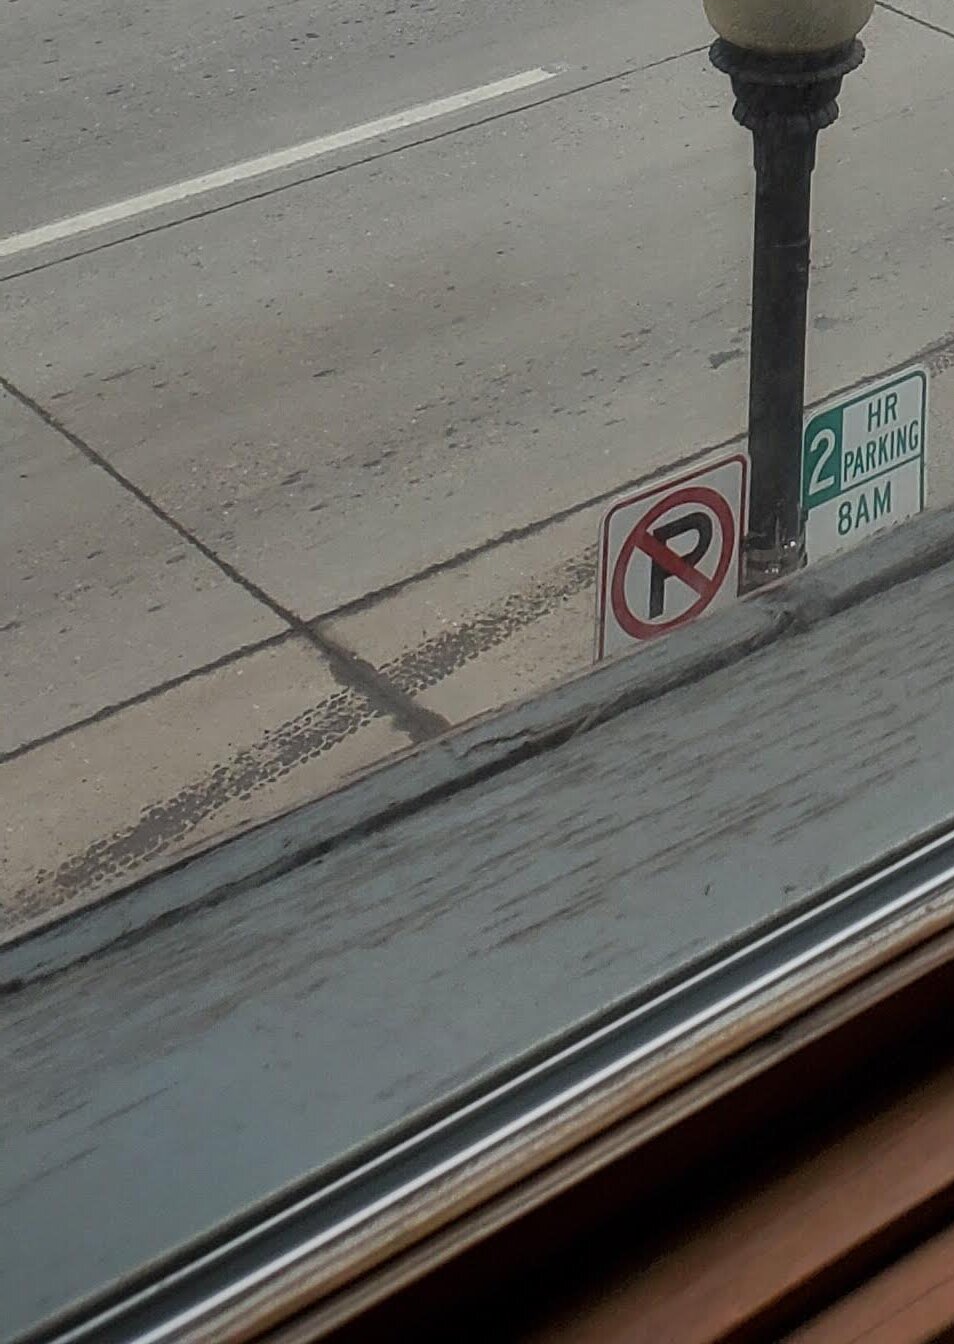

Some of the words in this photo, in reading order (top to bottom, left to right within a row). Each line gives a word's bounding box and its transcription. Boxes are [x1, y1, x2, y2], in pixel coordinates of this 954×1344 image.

[808, 428, 837, 496] 2
[867, 392, 899, 433] HR
[843, 419, 919, 483] PARKING
[837, 480, 892, 537] 8AM
